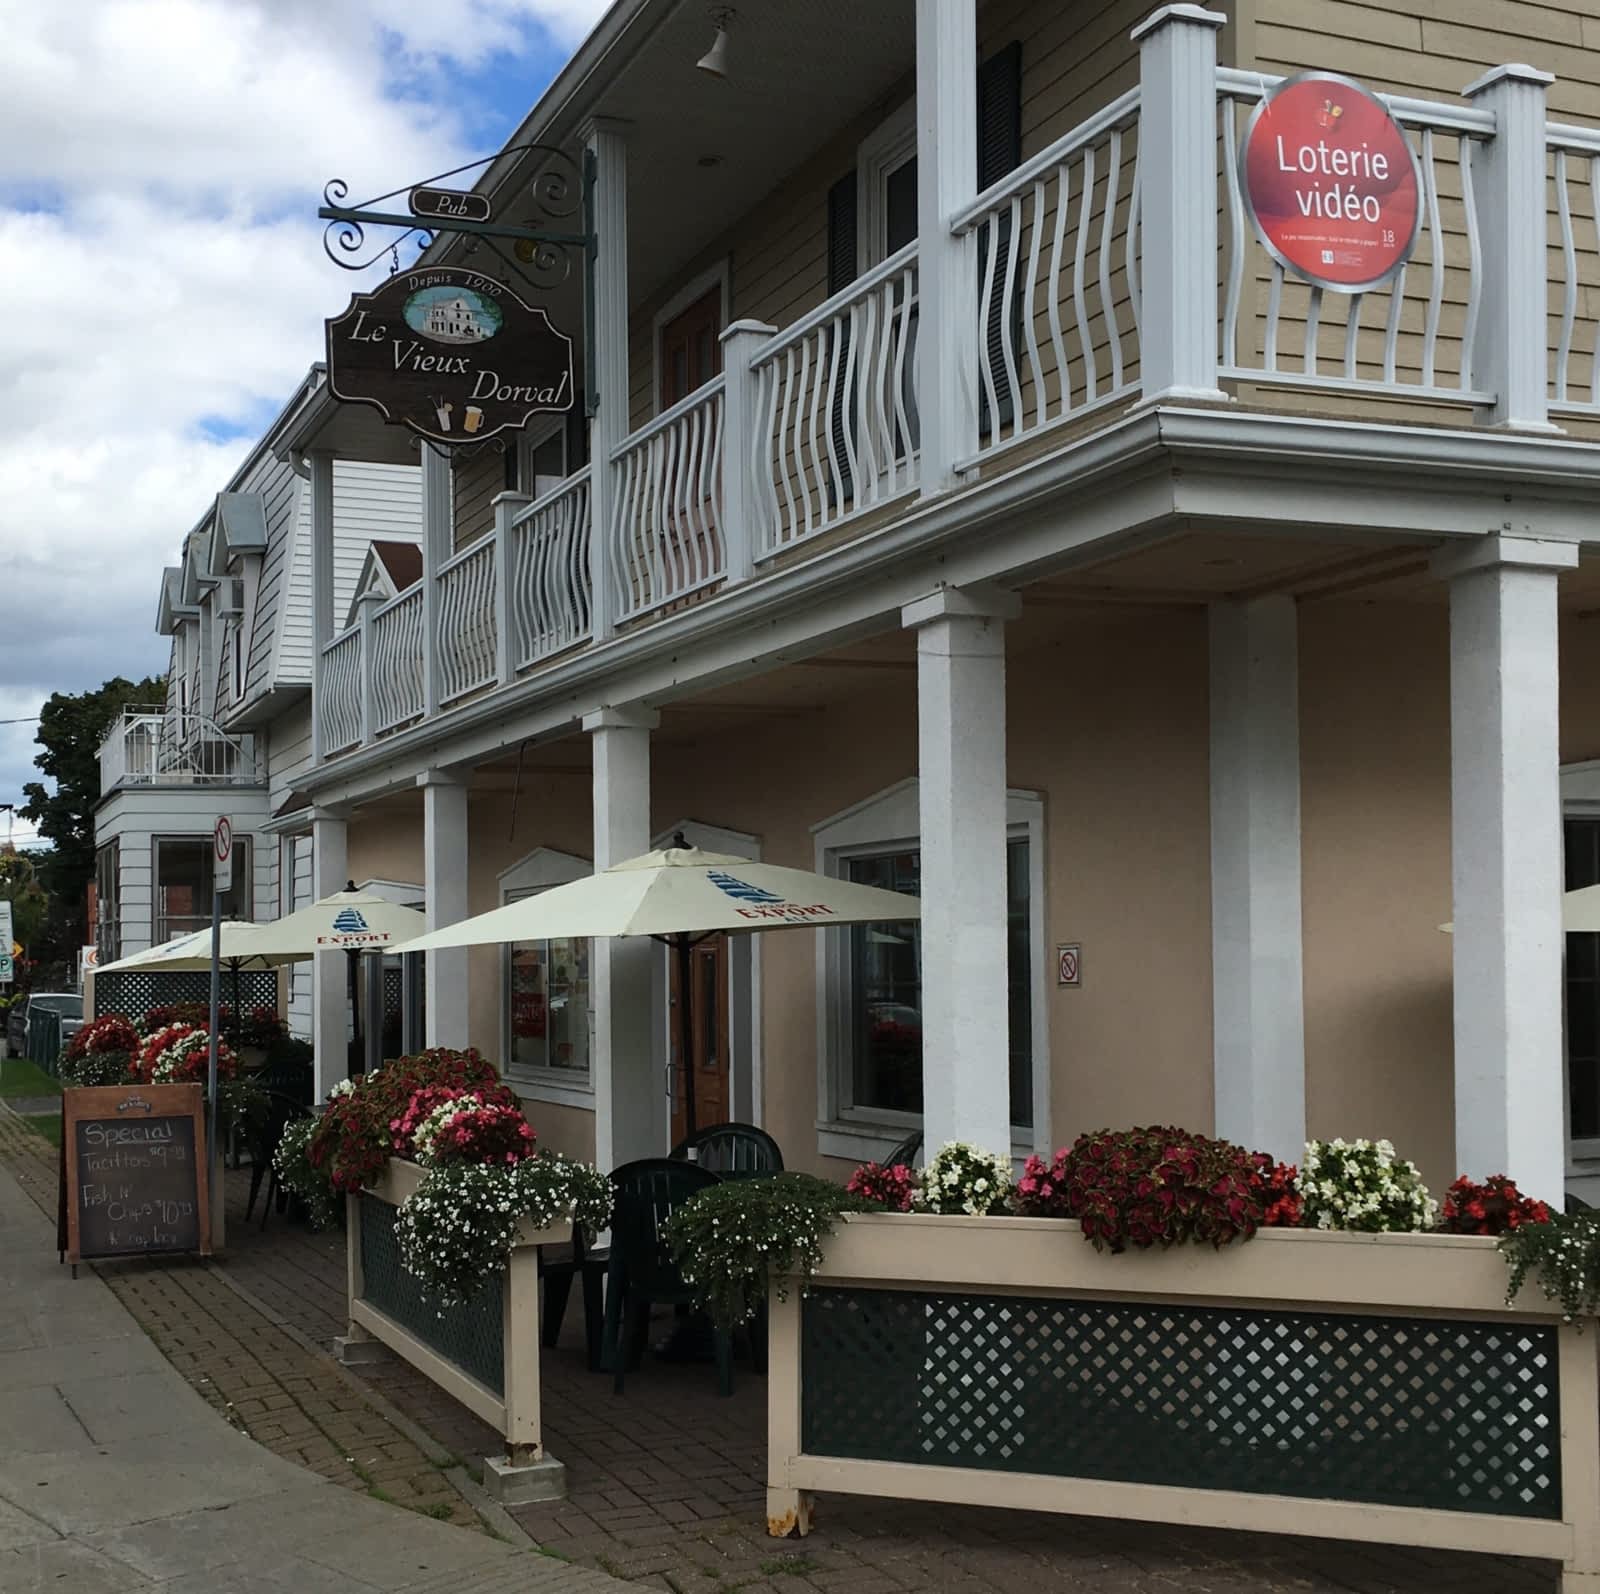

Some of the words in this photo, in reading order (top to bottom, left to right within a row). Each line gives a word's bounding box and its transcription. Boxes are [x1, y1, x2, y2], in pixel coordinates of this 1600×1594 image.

[1277, 135, 1389, 180] Loterie
[435, 195, 468, 215] Pub
[1296, 182, 1380, 222] vidéo
[1382, 229, 1395, 243] 18
[408, 273, 452, 291] Depuis
[464, 274, 502, 297] 1900
[348, 310, 386, 342] Le
[392, 339, 470, 374] Vieux
[468, 370, 569, 404] Dorval
[735, 905, 833, 919] EXPORT
[317, 932, 391, 944] EXPORT
[85, 1121, 172, 1147] Special
[82, 1184, 112, 1209] Fish
